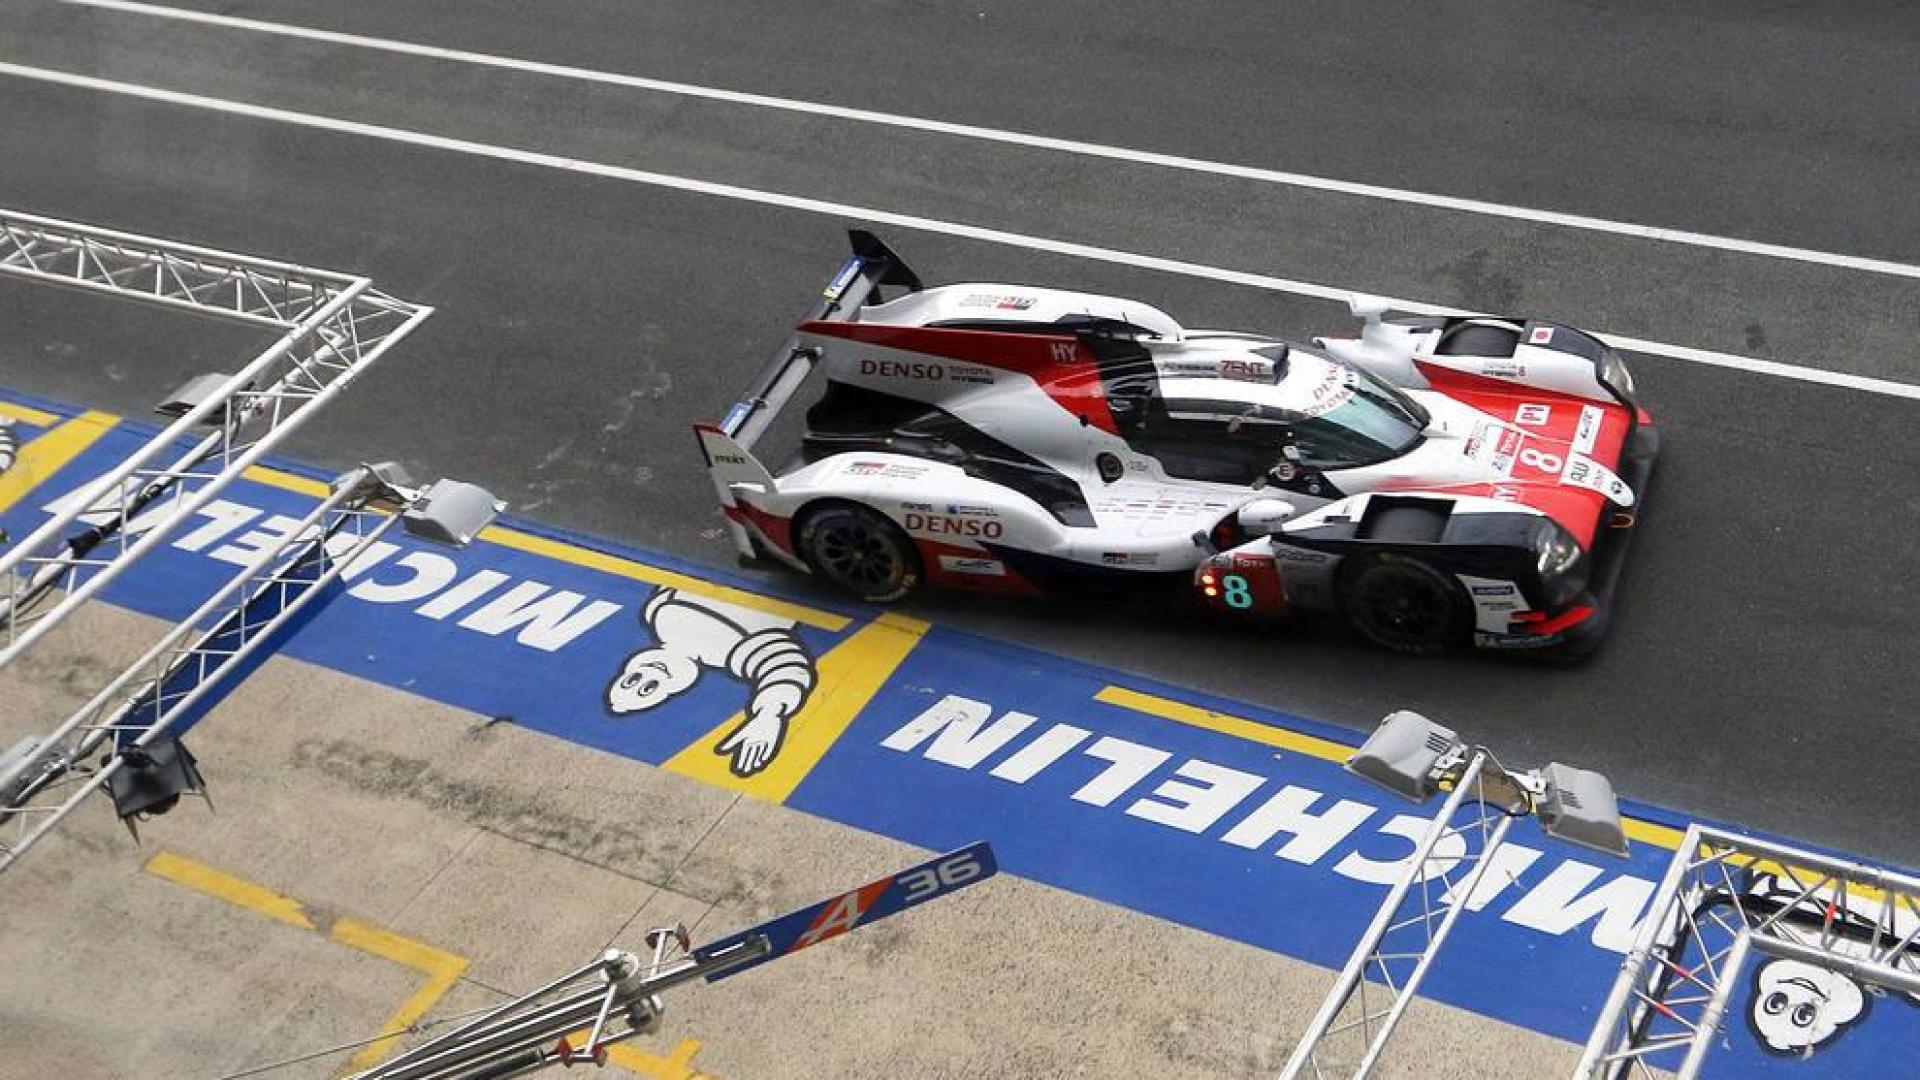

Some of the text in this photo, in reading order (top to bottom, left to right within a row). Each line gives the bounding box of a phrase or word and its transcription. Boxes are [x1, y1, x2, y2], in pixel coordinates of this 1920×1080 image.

[860, 359, 943, 380] DENSO
[1221, 359, 1266, 374] ZENT
[1520, 406, 1545, 421] P1
[1520, 448, 1562, 473] 8
[905, 513, 1002, 539] DENSO
[1222, 574, 1253, 609] 8
[880, 694, 1678, 955] MICHELIN
[897, 852, 981, 901] 36
